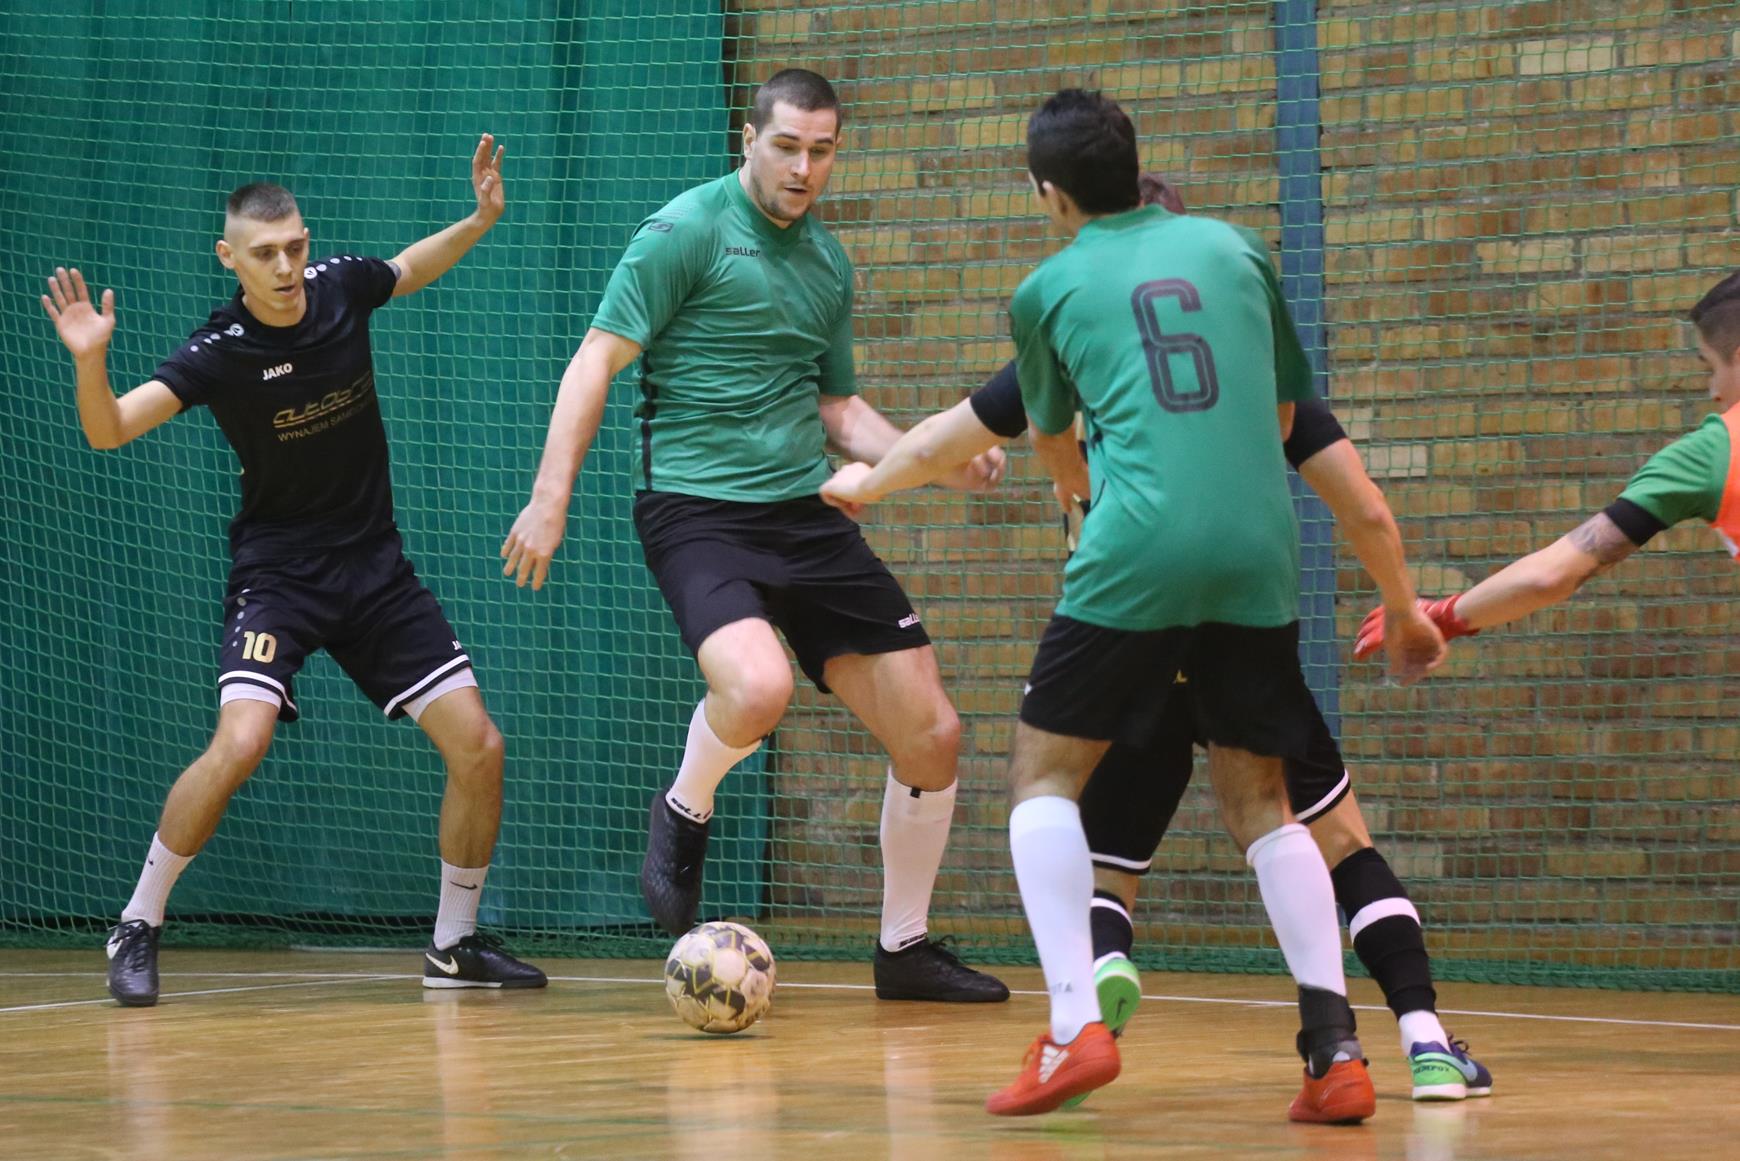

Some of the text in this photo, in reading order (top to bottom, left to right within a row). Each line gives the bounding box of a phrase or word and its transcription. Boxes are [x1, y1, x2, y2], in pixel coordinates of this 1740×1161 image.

[1131, 278, 1219, 413] 6
[263, 363, 293, 381] JAKO
[242, 631, 277, 664] 10
